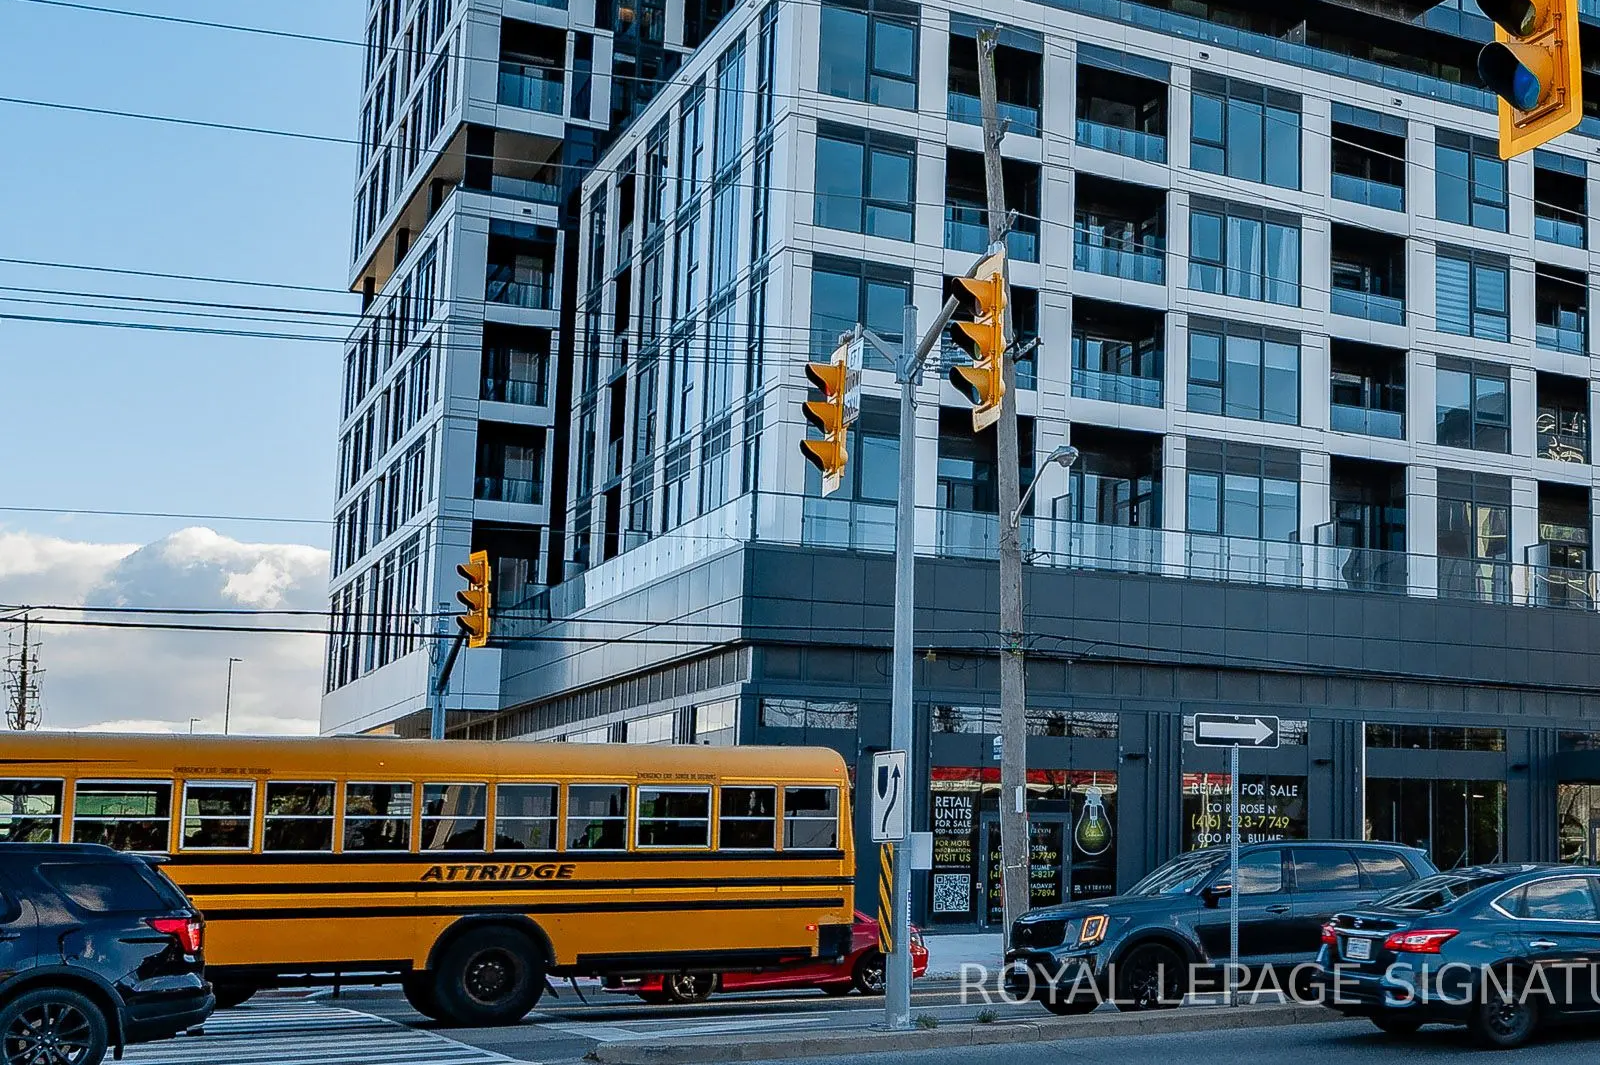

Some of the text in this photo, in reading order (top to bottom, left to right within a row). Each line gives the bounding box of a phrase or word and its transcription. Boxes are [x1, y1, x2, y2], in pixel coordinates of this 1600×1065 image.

[1191, 783, 1298, 797] RETAI FOR SALE
[935, 796, 972, 808] RETAIL
[1206, 803, 1232, 813] COR
[935, 808, 972, 820] UNITS
[935, 820, 972, 828] FOR SALE
[1191, 813, 1221, 830] (416)
[1197, 833, 1242, 843] COOPR
[935, 854, 971, 862] VISIT US
[1031, 851, 1057, 860] 3-7749
[420, 864, 576, 881] ATTRIDGE
